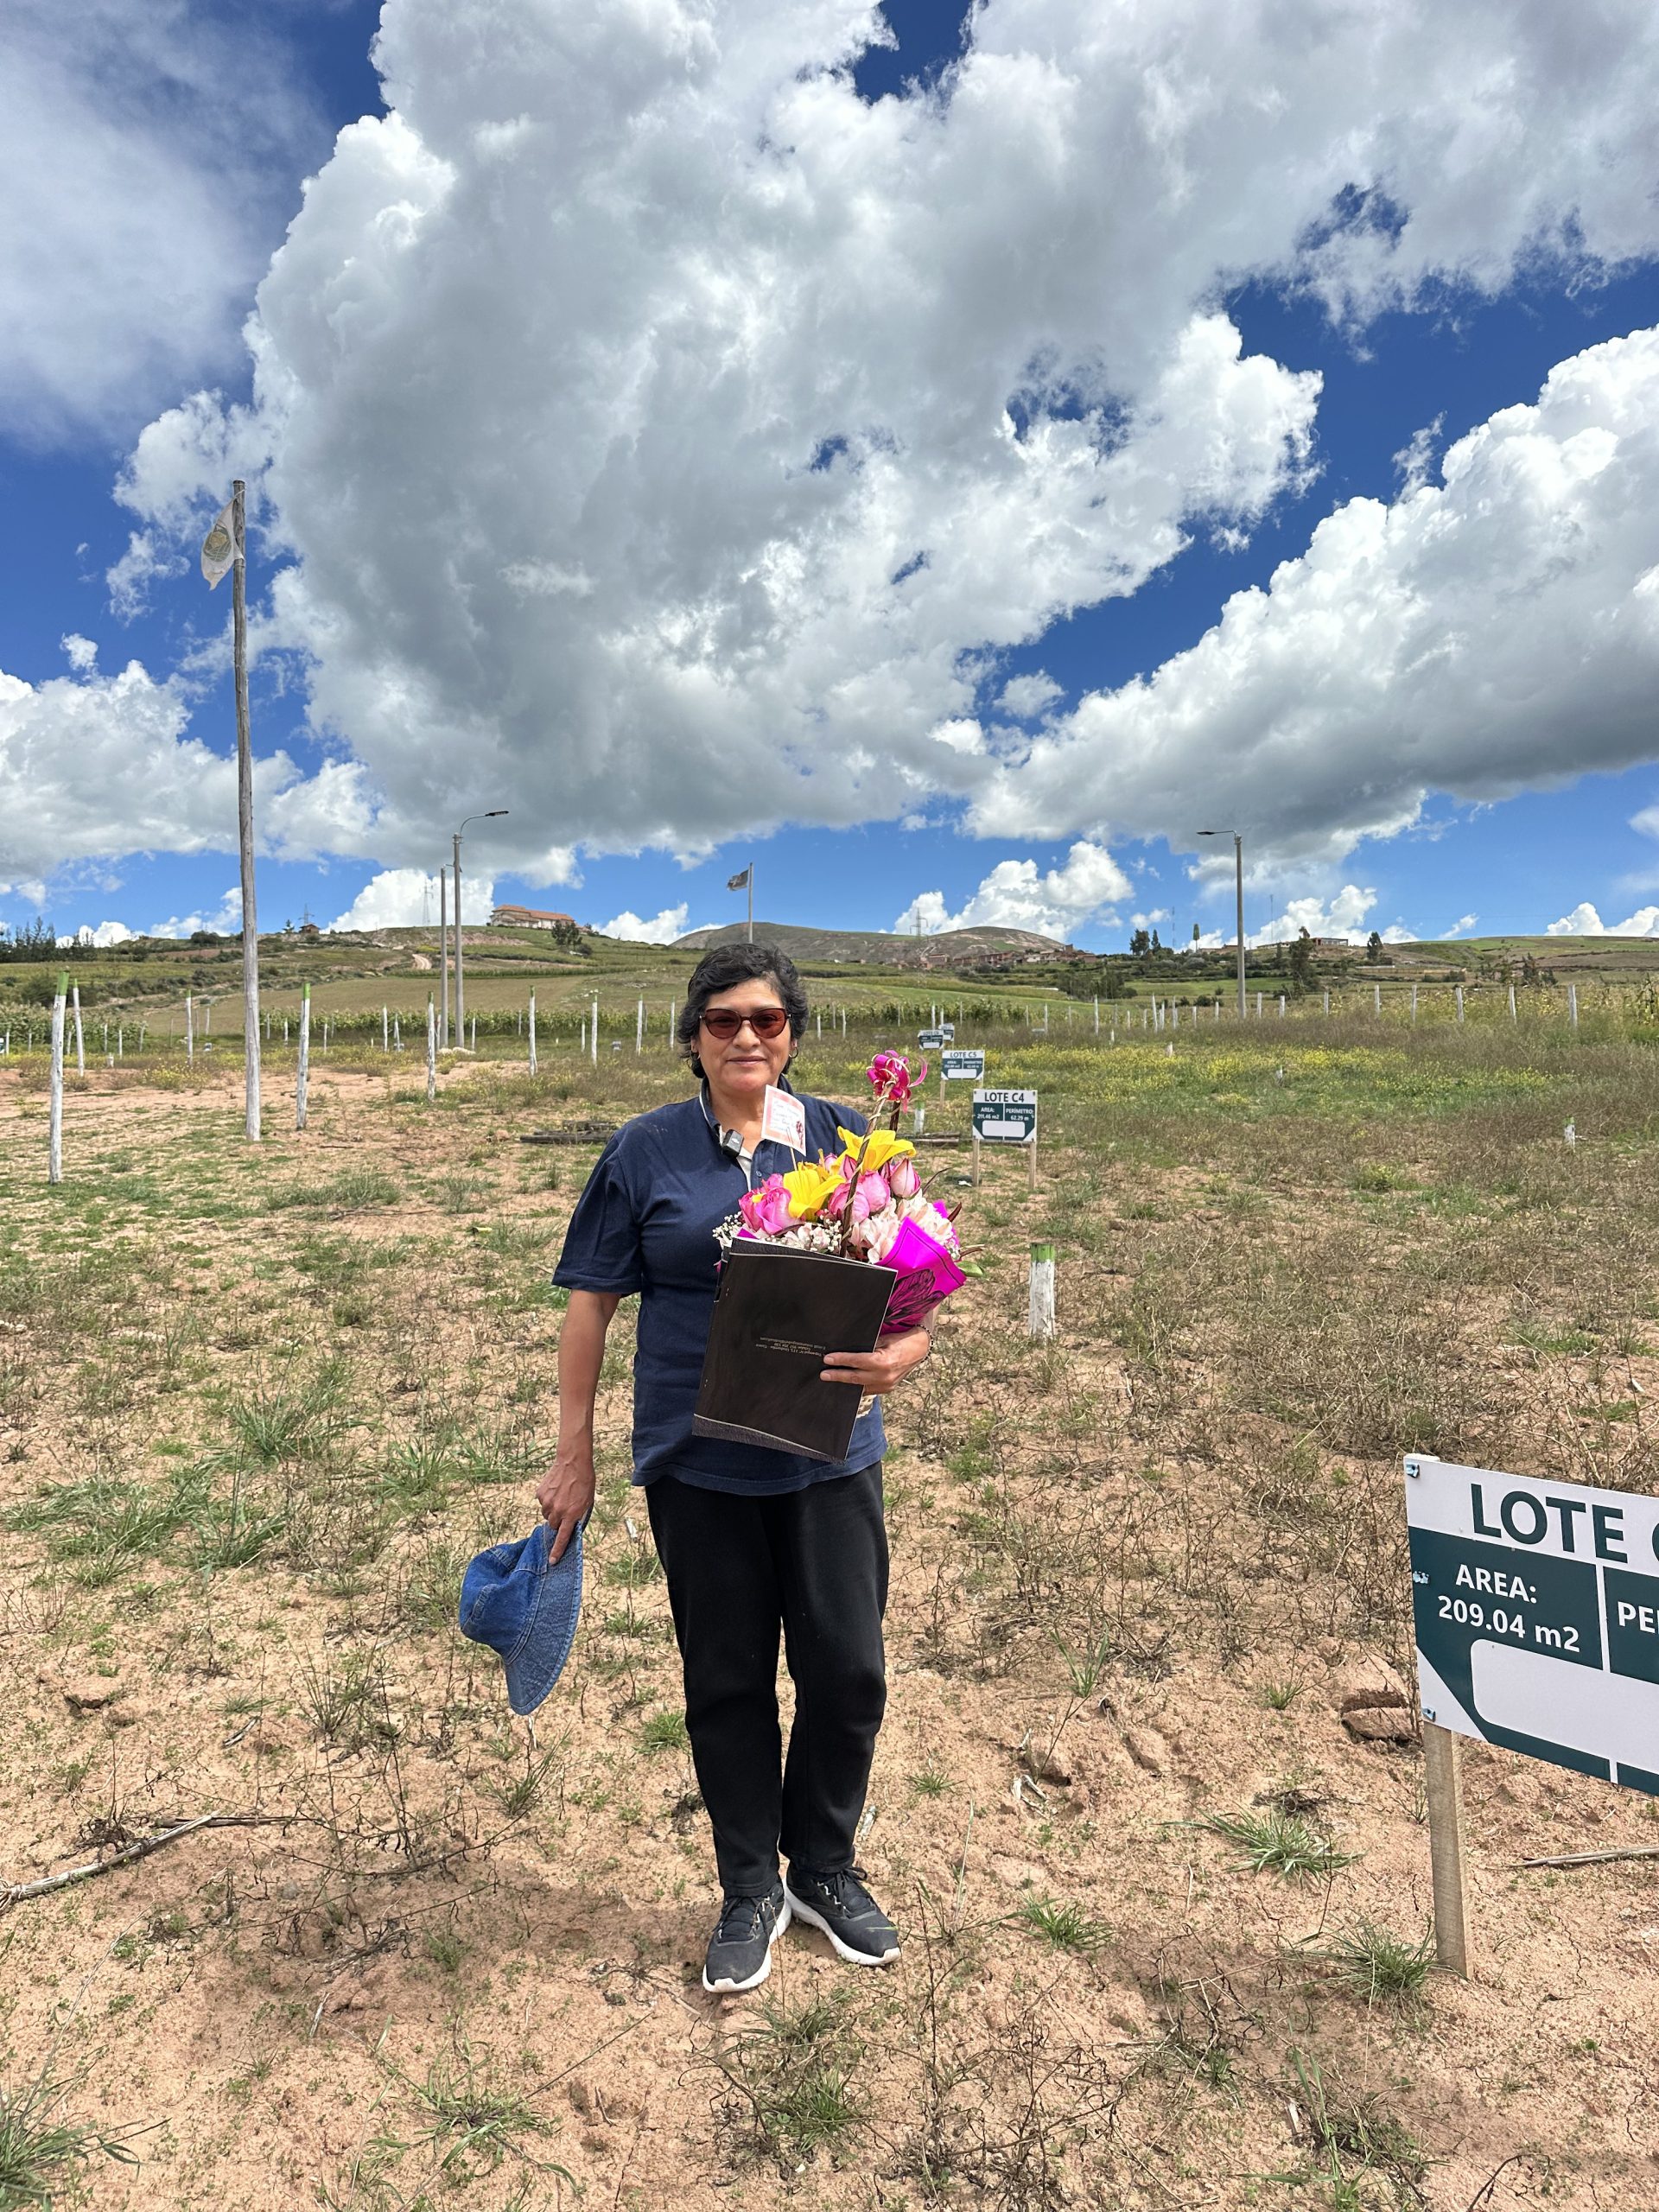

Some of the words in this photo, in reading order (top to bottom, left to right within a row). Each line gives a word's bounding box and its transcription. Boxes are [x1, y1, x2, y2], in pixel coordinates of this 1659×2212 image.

[984, 1092, 1008, 1103] LOTE
[1012, 1092, 1025, 1103] C4
[1471, 1483, 1629, 1564] LOTE
[1455, 1564, 1537, 1604] AREA:
[1438, 1595, 1526, 1639] 209.04
[1535, 1624, 1580, 1653] m2
[1618, 1601, 1659, 1635] PE
